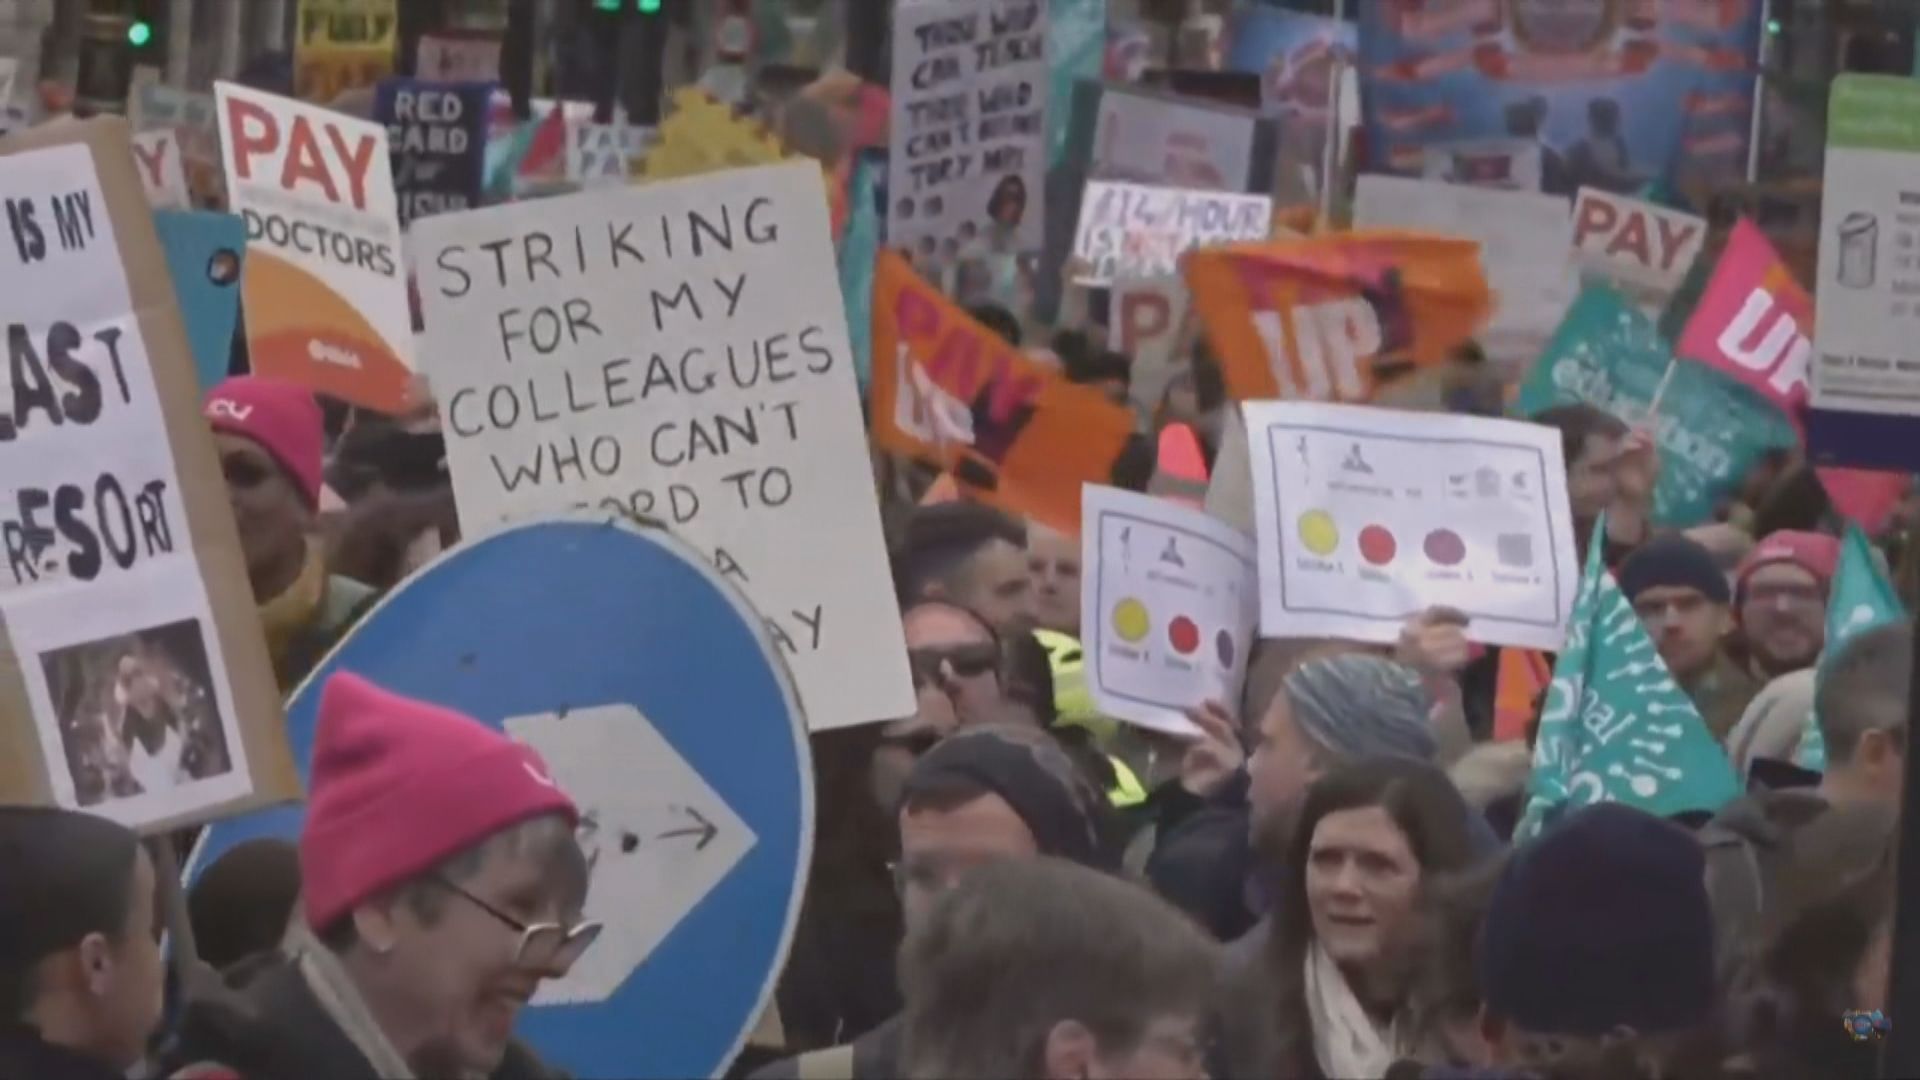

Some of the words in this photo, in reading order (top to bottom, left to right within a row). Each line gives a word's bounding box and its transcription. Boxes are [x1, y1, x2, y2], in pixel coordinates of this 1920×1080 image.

[394, 91, 463, 122] RED
[226, 96, 377, 212] PAY
[6, 198, 47, 264] IS
[51, 191, 95, 251] MY
[241, 209, 396, 278] DOCTORS
[436, 198, 778, 298] STRIKING
[1573, 196, 1697, 270] PAY
[498, 298, 602, 363] FOR
[651, 274, 746, 331] MY
[895, 287, 1045, 423] PAY
[1252, 296, 1382, 400] UP
[449, 326, 833, 438] COLLEAGUES
[490, 436, 621, 493] WHO
[650, 402, 800, 467] CAN'T
[721, 467, 791, 509] TO
[3, 472, 174, 585] RESORT
